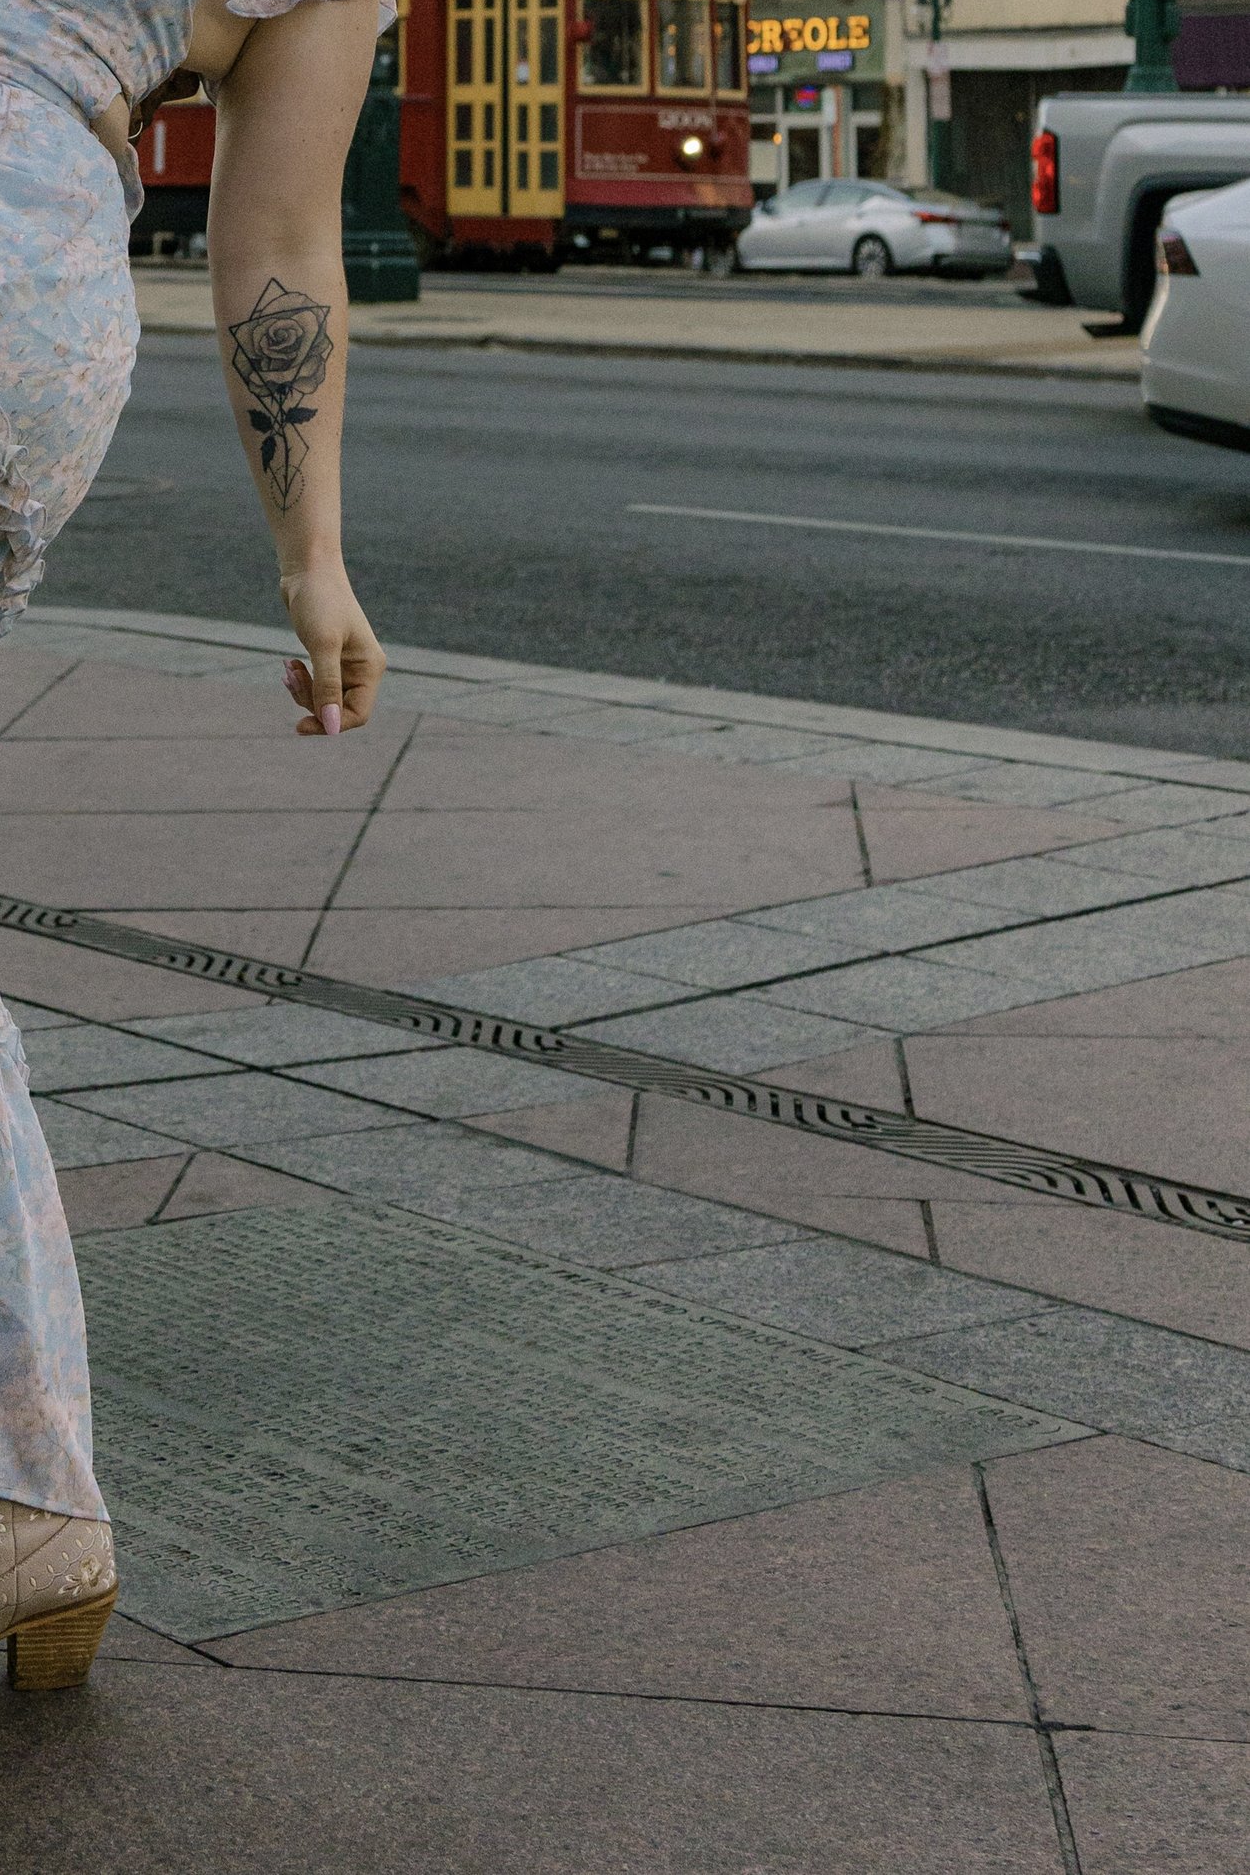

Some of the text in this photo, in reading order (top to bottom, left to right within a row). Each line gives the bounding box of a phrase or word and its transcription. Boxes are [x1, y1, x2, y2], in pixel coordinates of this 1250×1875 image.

[391, 1221, 479, 1246] STREET
[467, 1245, 554, 1270] UNDER
[540, 1269, 644, 1299] FRENCH
[630, 1298, 696, 1316] AND
[683, 1315, 799, 1349] SPANISH
[784, 1347, 864, 1370] RULE
[115, 1464, 161, 1480] THE
[148, 1479, 246, 1516] AUSPICES
[260, 1527, 308, 1544] THE
[296, 1543, 362, 1567] CORE
[127, 1484, 216, 1519] ORLEANS
[207, 1519, 256, 1536] AND
[246, 1536, 294, 1553] THE
[183, 1457, 230, 1472] THE
[343, 1523, 416, 1549] LATER
[196, 1478, 247, 1496] OUR
[236, 1495, 299, 1517] CITY.
[237, 1463, 311, 1490] STREET
[303, 1490, 355, 1508] THEN
[351, 1510, 439, 1542] BECAME
[431, 1543, 482, 1560] THE
[241, 1450, 293, 1468] LAID
[281, 1467, 330, 1483] OUT
[388, 1510, 448, 1531] STILL
[152, 1543, 257, 1586] MARGARET
[161, 1513, 261, 1553] DEDICATED
[248, 1551, 322, 1579] SPRING
